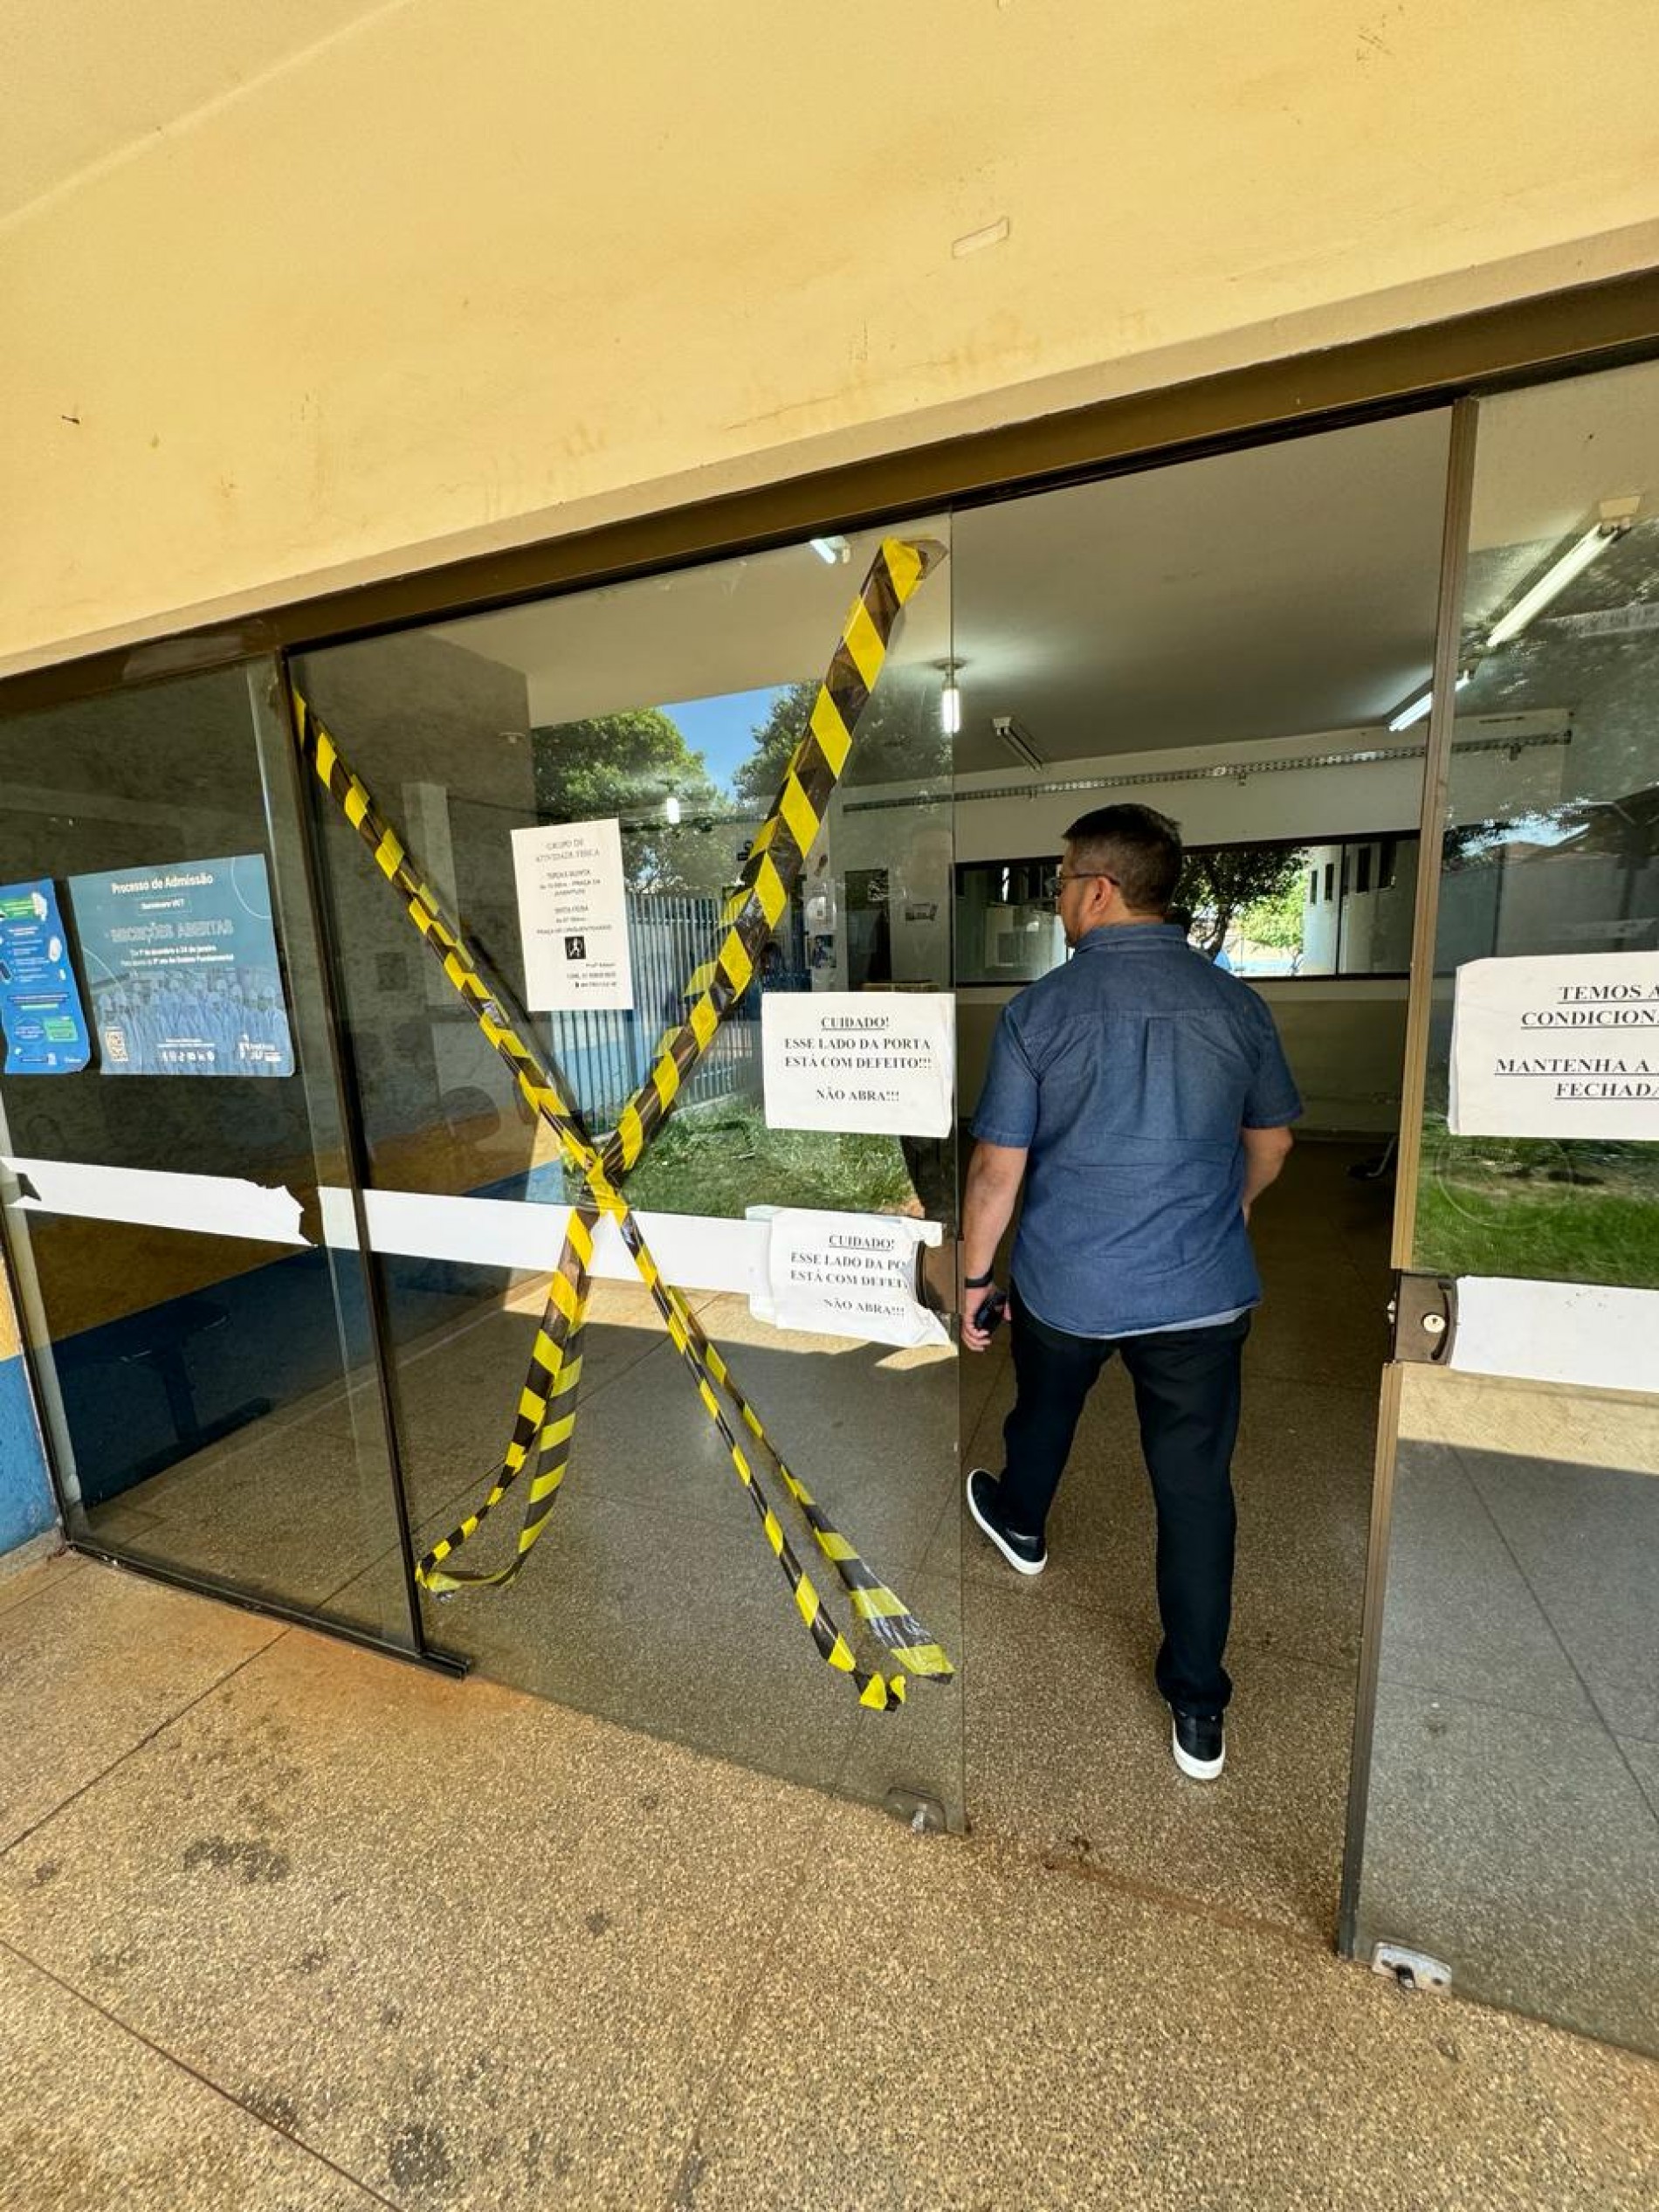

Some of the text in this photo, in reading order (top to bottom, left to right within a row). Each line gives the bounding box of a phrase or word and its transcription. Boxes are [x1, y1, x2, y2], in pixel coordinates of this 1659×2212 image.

[111, 872, 214, 894] Processo de Admissão
[177, 919, 234, 939] ABERTAS
[1559, 984, 1642, 1001] TEMOS
[821, 1016, 890, 1030] CUIDADO!
[1521, 1009, 1659, 1026] CONDICION
[784, 1037, 931, 1050] ESSE LADO DA PORTA
[784, 1054, 932, 1069] ESTÁ COM DEFEITO!!!
[1495, 1058, 1650, 1073] MANTENHA A
[816, 1087, 899, 1102] NÃO ABRA!!!
[829, 1235, 895, 1251] CUIDADO!
[791, 1252, 823, 1266] ESSE
[824, 1254, 862, 1269] LADO
[865, 1258, 884, 1271] DA
[790, 1269, 823, 1283] ESTÁ
[825, 1272, 857, 1286] COM
[823, 1298, 853, 1312] NÃO
